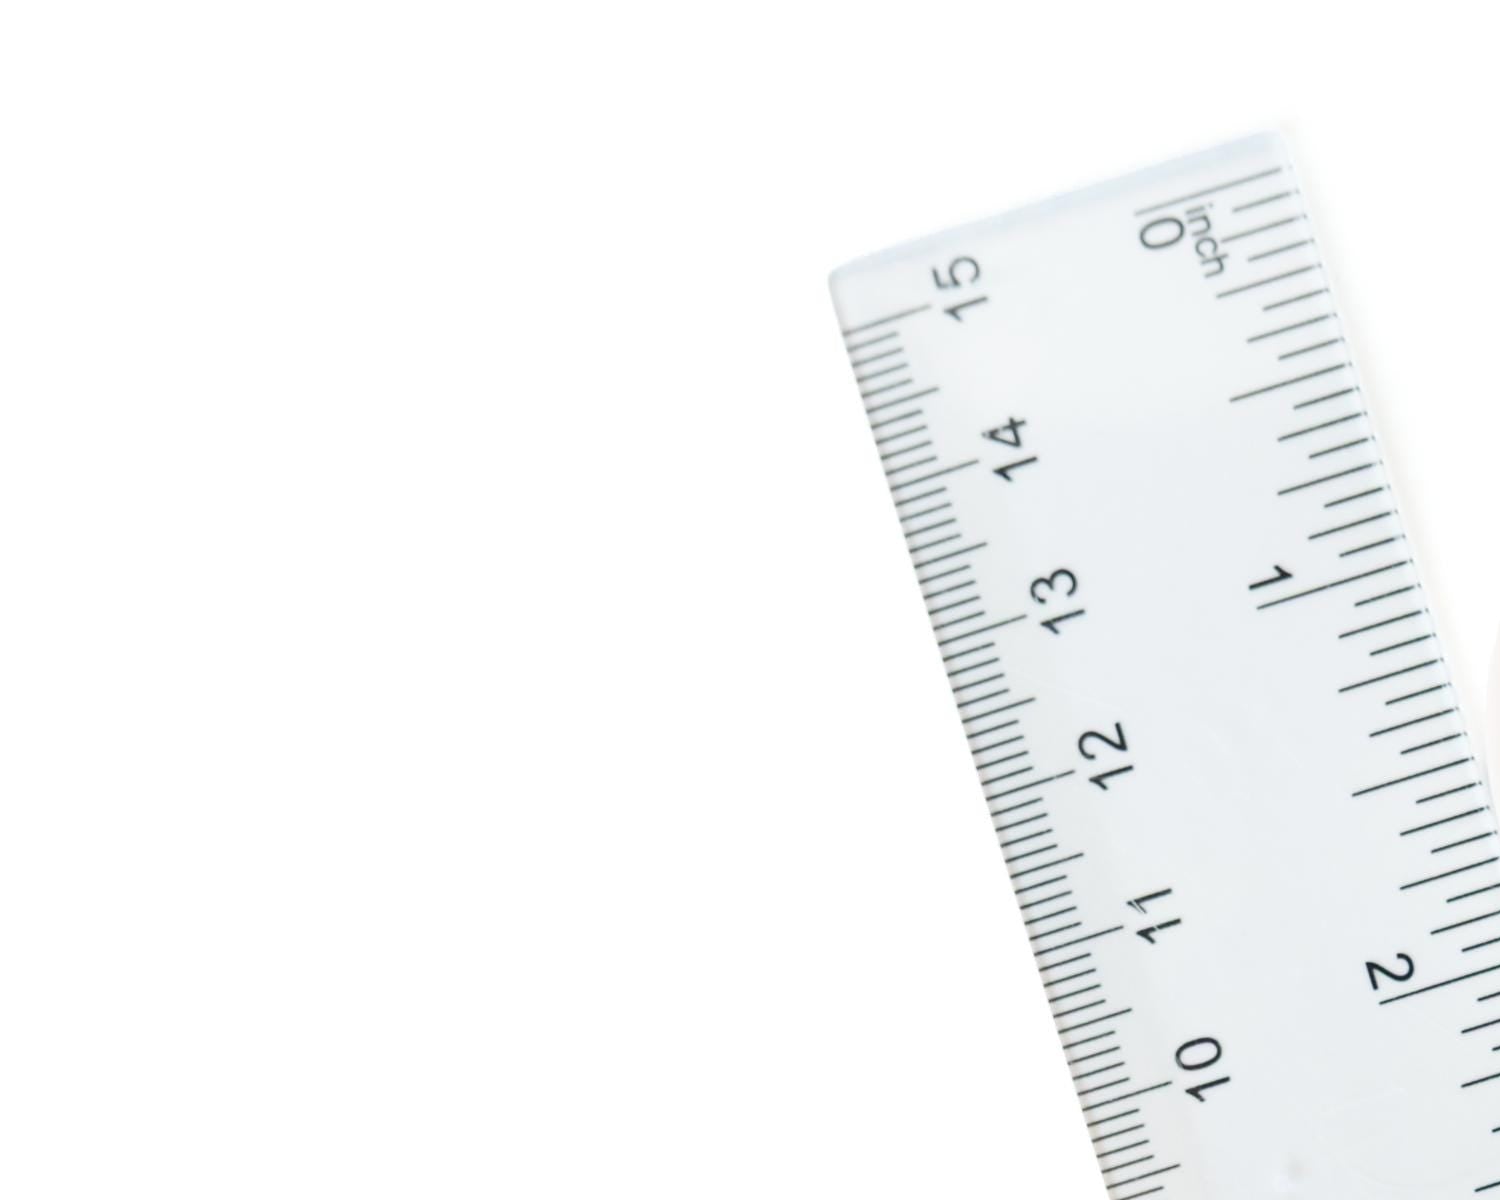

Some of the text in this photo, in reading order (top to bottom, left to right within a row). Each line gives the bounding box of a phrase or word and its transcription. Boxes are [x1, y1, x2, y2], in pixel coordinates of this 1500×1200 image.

[1139, 217, 1184, 250] 0
[1185, 202, 1228, 278] inch
[932, 256, 988, 322] 15
[981, 416, 1038, 482] 14
[1029, 568, 1086, 635] 13
[1248, 565, 1293, 591] 1
[1077, 722, 1134, 791] 12
[1126, 888, 1182, 945] 11
[1365, 952, 1415, 991] 2
[1174, 1037, 1231, 1103] 10
